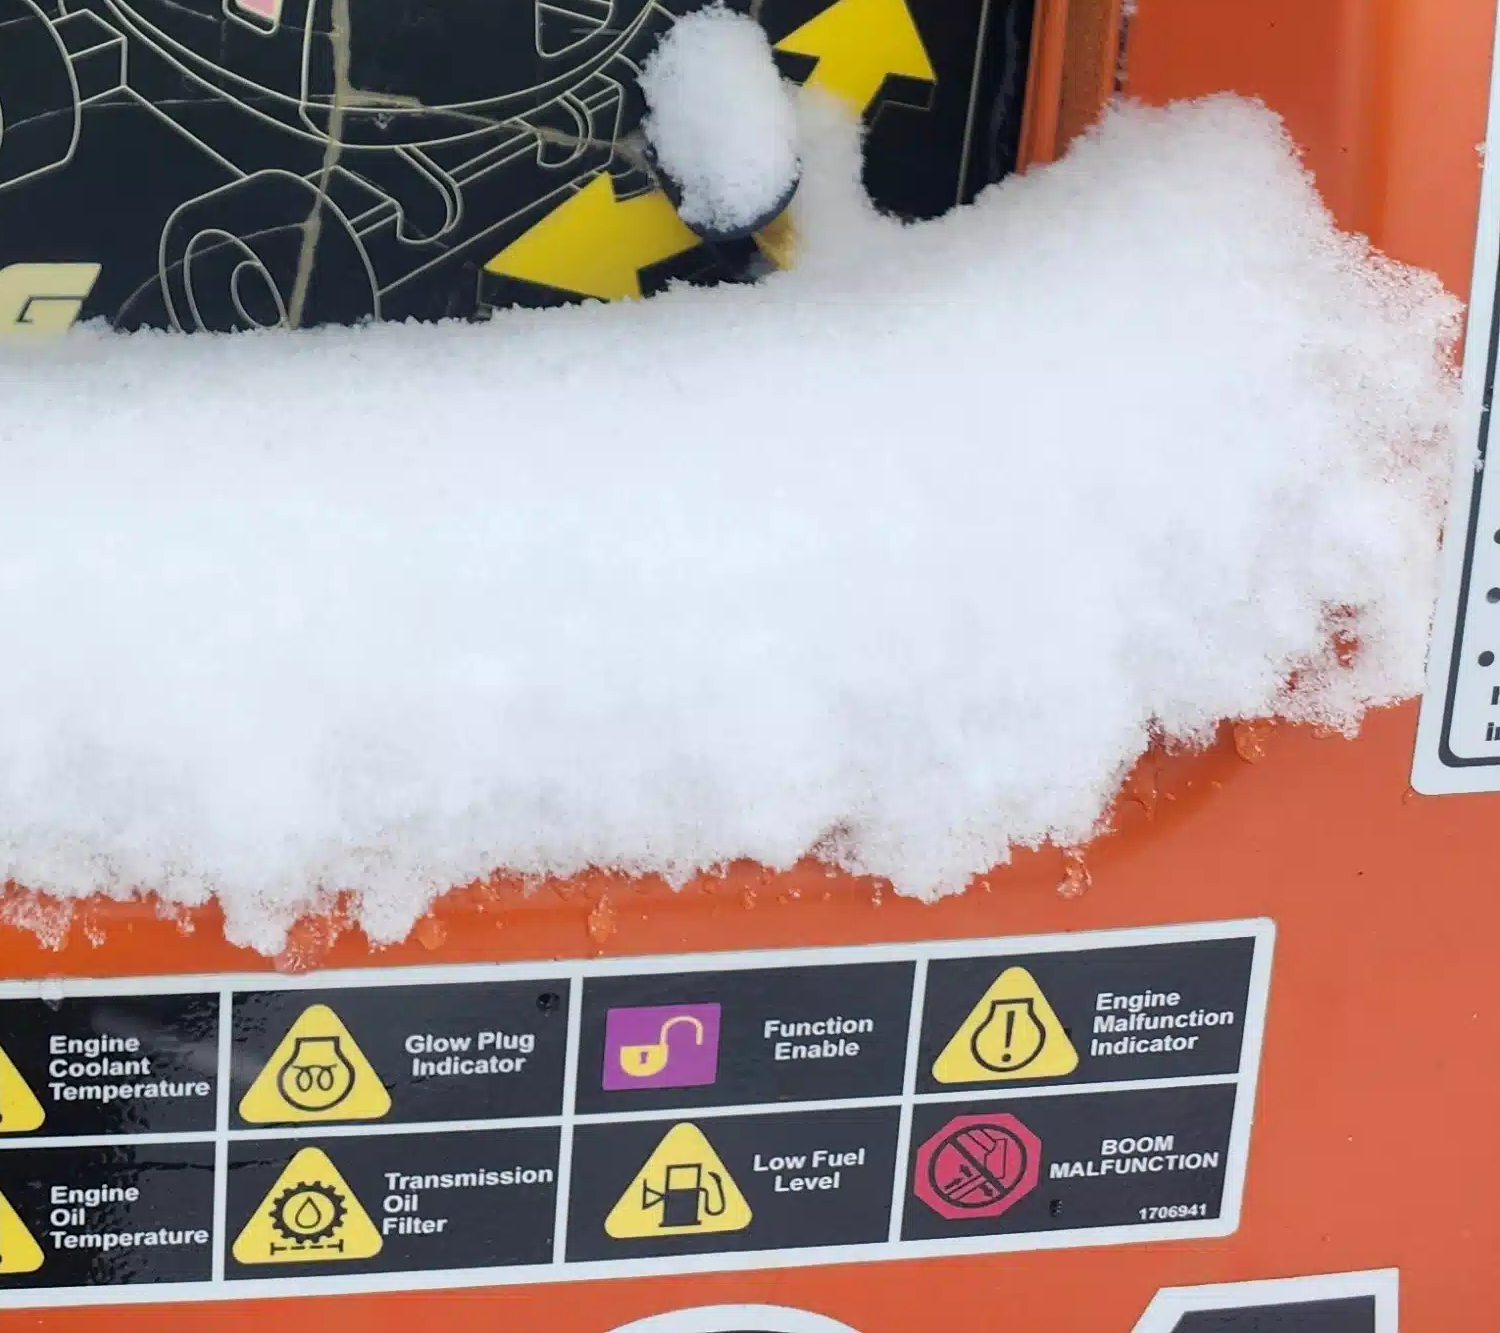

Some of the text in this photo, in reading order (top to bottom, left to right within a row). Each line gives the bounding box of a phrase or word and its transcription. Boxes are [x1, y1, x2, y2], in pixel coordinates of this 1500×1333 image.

[1096, 990, 1180, 1012] Engine
[765, 1017, 873, 1038] Function
[1093, 1011, 1233, 1033] Malfunction
[50, 1035, 139, 1057] Engine
[405, 1032, 534, 1053] Glow Plug
[775, 1039, 859, 1060] Enable
[1091, 1035, 1198, 1056] Indicator
[50, 1058, 150, 1077] Coolant
[413, 1056, 526, 1076] Indicator
[49, 1080, 210, 1103] Temperature
[1101, 1136, 1173, 1155] BOOM
[754, 1148, 864, 1171] Low Fuel
[1050, 1152, 1218, 1178] MALFUNCTION
[385, 1167, 553, 1190] Transmission
[775, 1172, 839, 1192] Level
[51, 1184, 139, 1206] Engine
[384, 1194, 418, 1213] Oil
[51, 1208, 84, 1226] Oil
[1139, 1204, 1206, 1219] 1706941
[383, 1217, 447, 1234] Filter
[50, 1228, 209, 1251] Temperature
